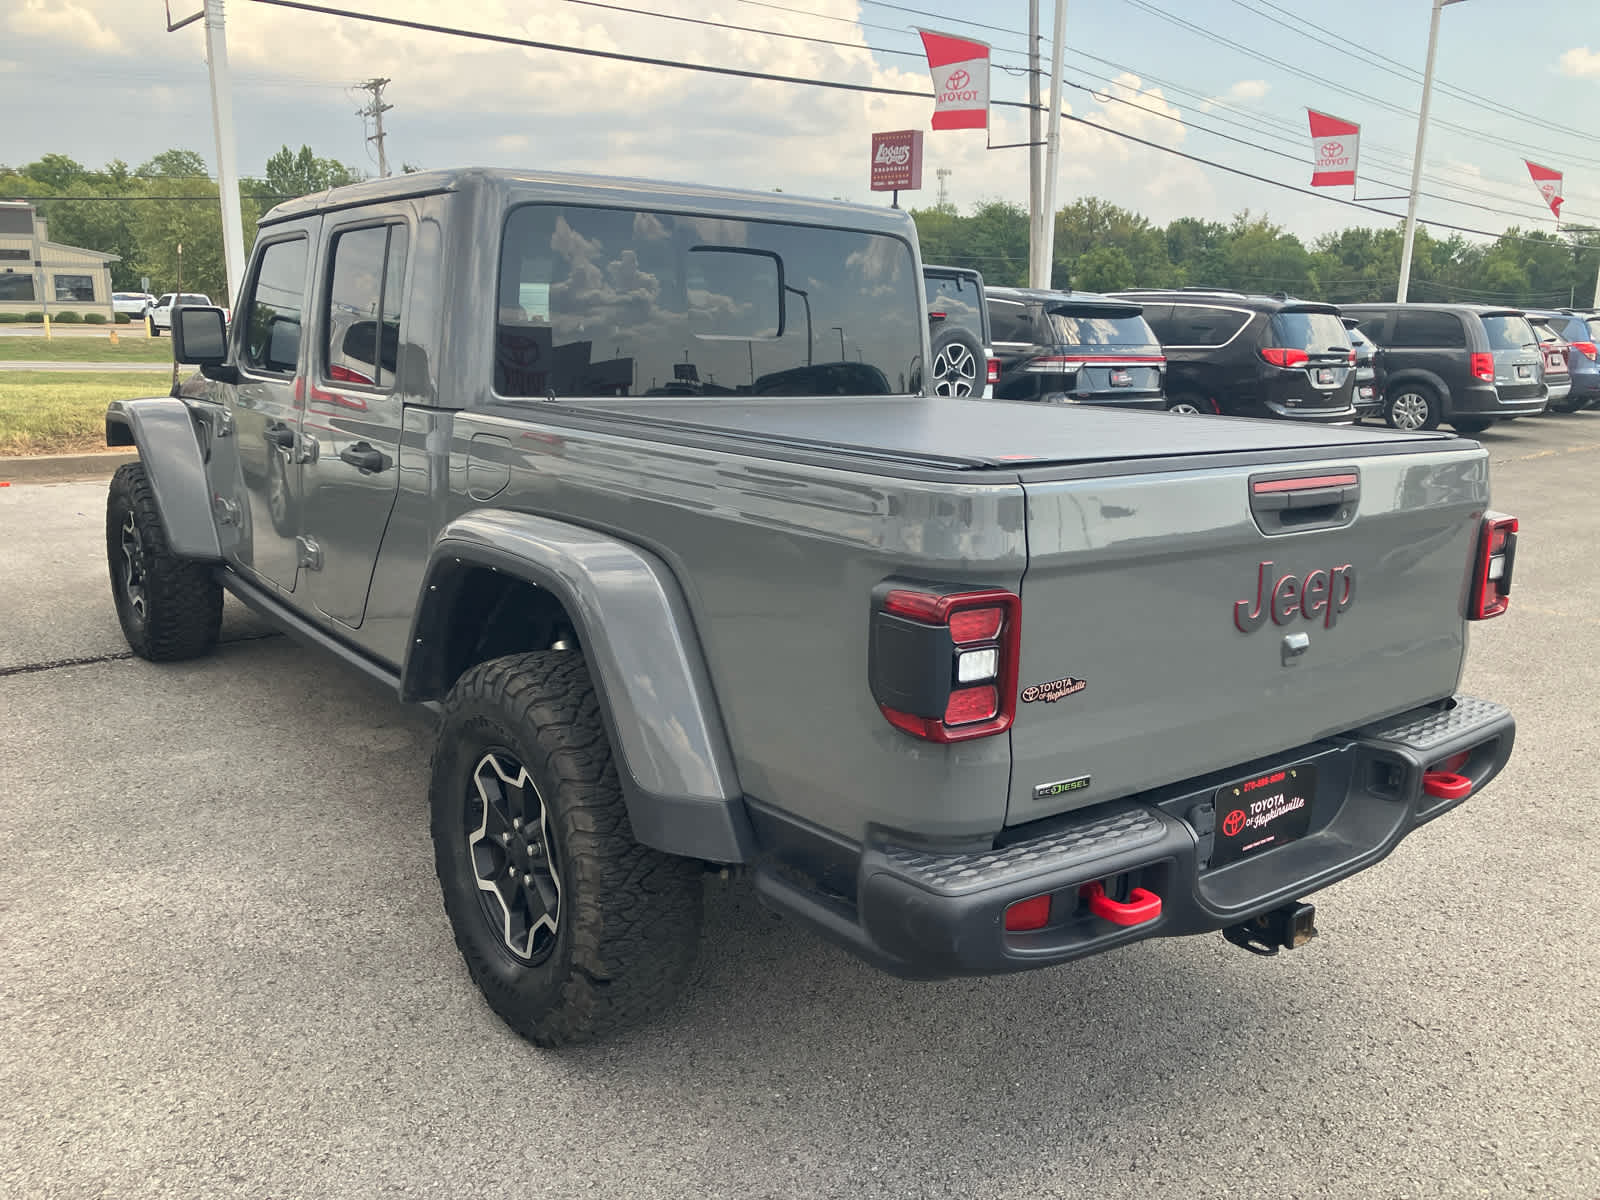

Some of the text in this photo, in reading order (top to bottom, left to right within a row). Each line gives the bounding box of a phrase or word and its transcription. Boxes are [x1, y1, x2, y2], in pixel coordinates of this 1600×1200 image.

[1233, 561, 1354, 633] Jeep
[1040, 679, 1071, 692] TOYOTA
[1250, 793, 1284, 814] TOYOTA
[1253, 797, 1304, 828] Hopkinsville
